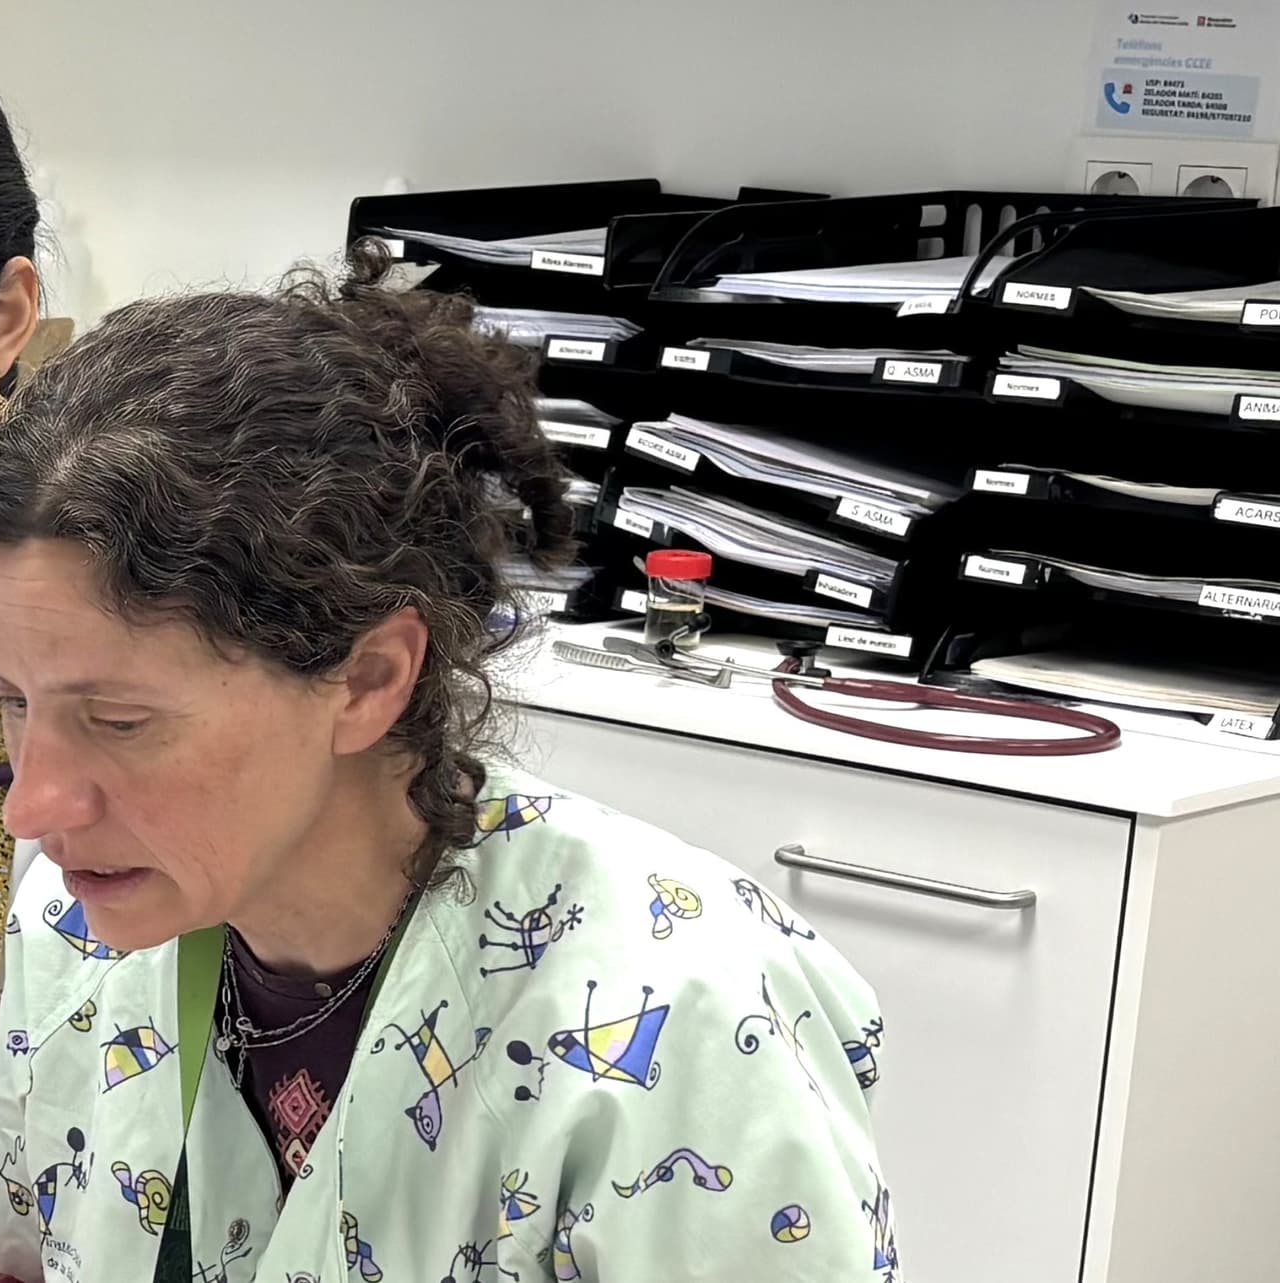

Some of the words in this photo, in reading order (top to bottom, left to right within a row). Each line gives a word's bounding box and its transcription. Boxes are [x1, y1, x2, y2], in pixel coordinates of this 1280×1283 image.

[1259, 308, 1280, 321] PO
[903, 366, 936, 379] ASMA
[1220, 717, 1255, 732] LATEX
